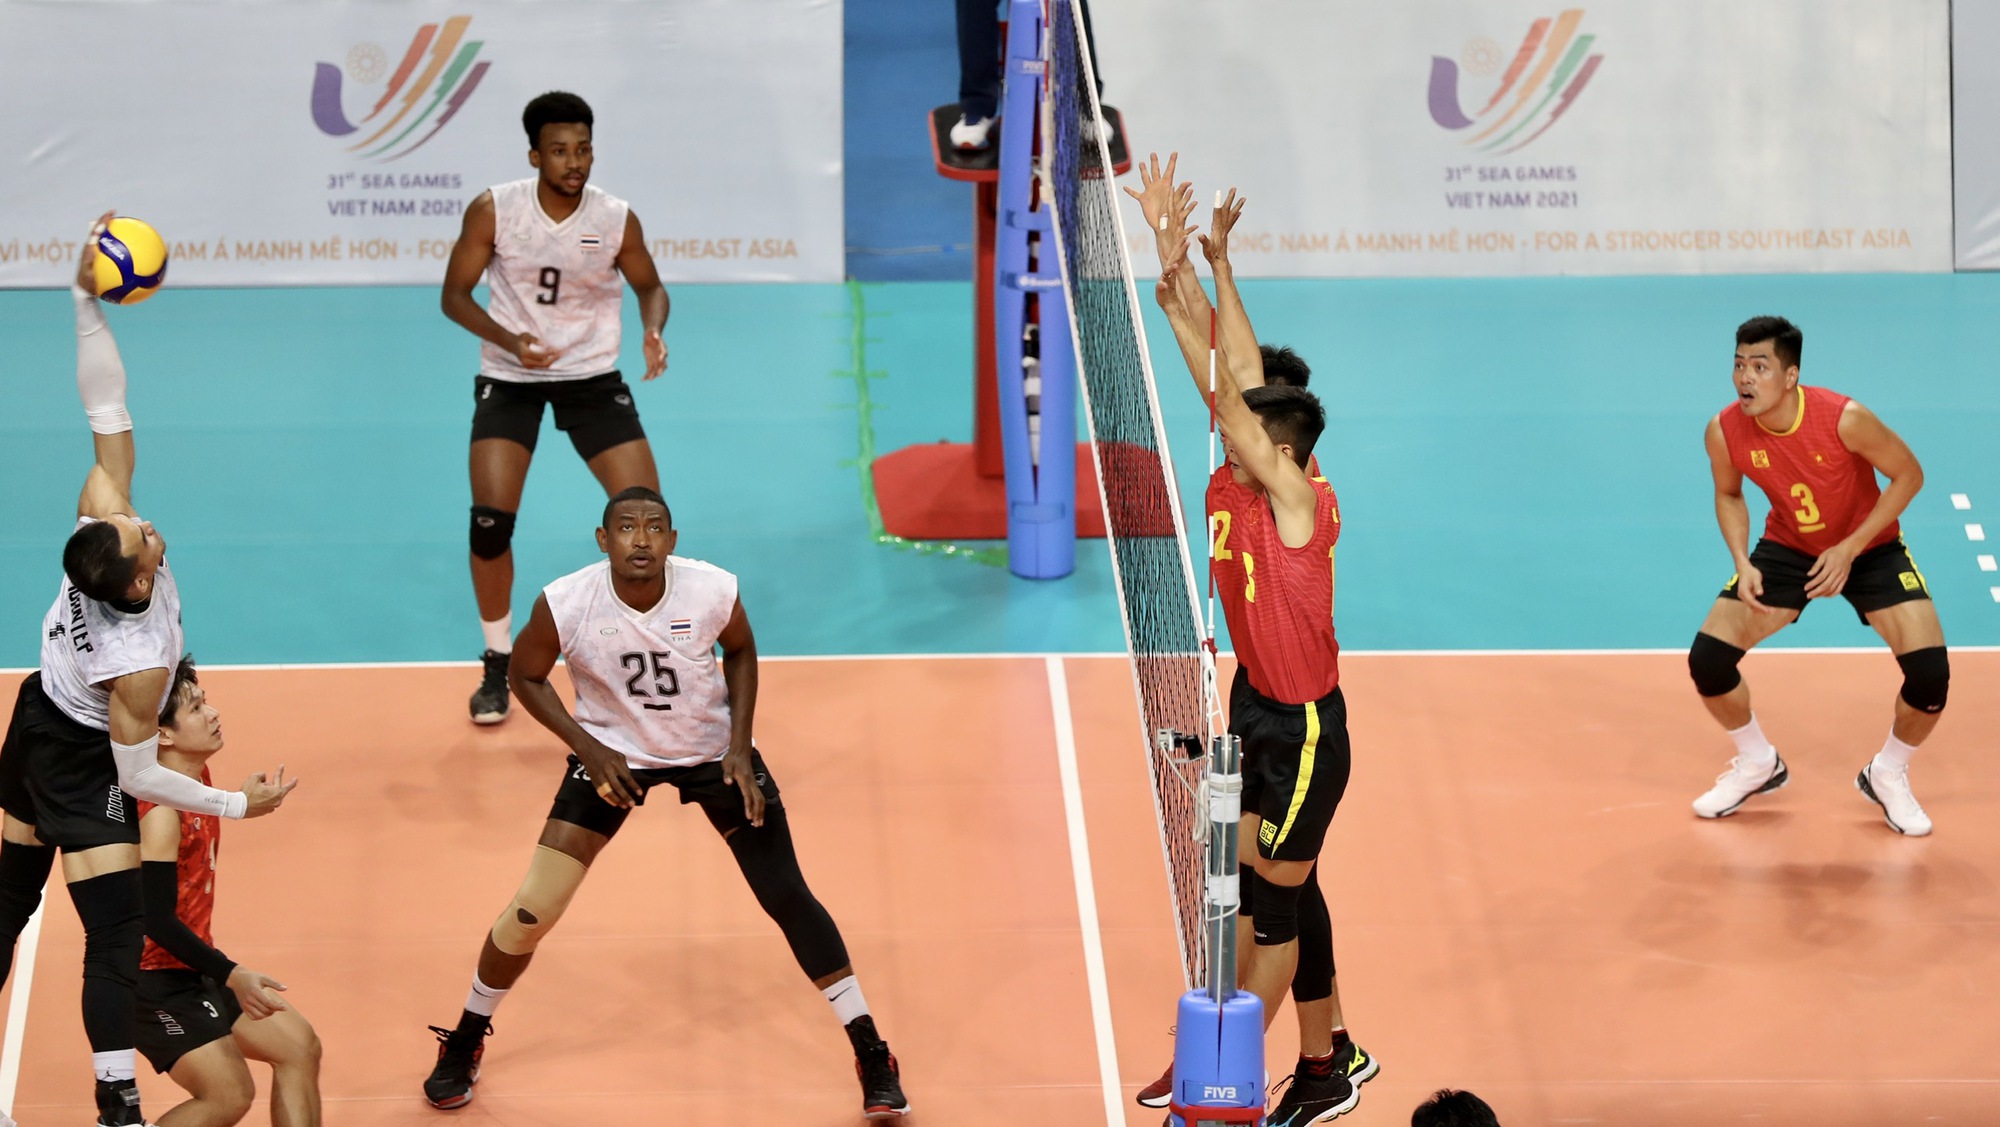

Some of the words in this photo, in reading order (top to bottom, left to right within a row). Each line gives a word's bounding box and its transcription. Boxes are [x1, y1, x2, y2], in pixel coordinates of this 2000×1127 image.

[361, 174, 395, 189] SEA
[400, 174, 462, 189] GAMES
[1478, 167, 1511, 182] SEA
[1516, 167, 1577, 182] GAMES
[328, 199, 367, 215] VIET
[372, 199, 416, 215] NAM
[421, 199, 462, 215] 2021
[1446, 192, 1484, 208] VIET
[1489, 192, 1531, 208] NAM
[1537, 191, 1578, 208] 2021
[167, 240, 208, 260] AM
[235, 240, 303, 265] MẠNH
[747, 238, 798, 259] ASIA
[1279, 232, 1329, 252] NAM
[1356, 231, 1422, 256] MẠNH
[1534, 231, 1577, 251] FOR
[1584, 231, 1600, 250] A
[1605, 230, 1721, 251] STRONGER
[1727, 228, 1855, 250] SOUTHEAST
[1862, 228, 1912, 249] ASIA
[536, 267, 561, 305] 9
[1790, 482, 1820, 525] 3
[620, 650, 681, 698] 25
